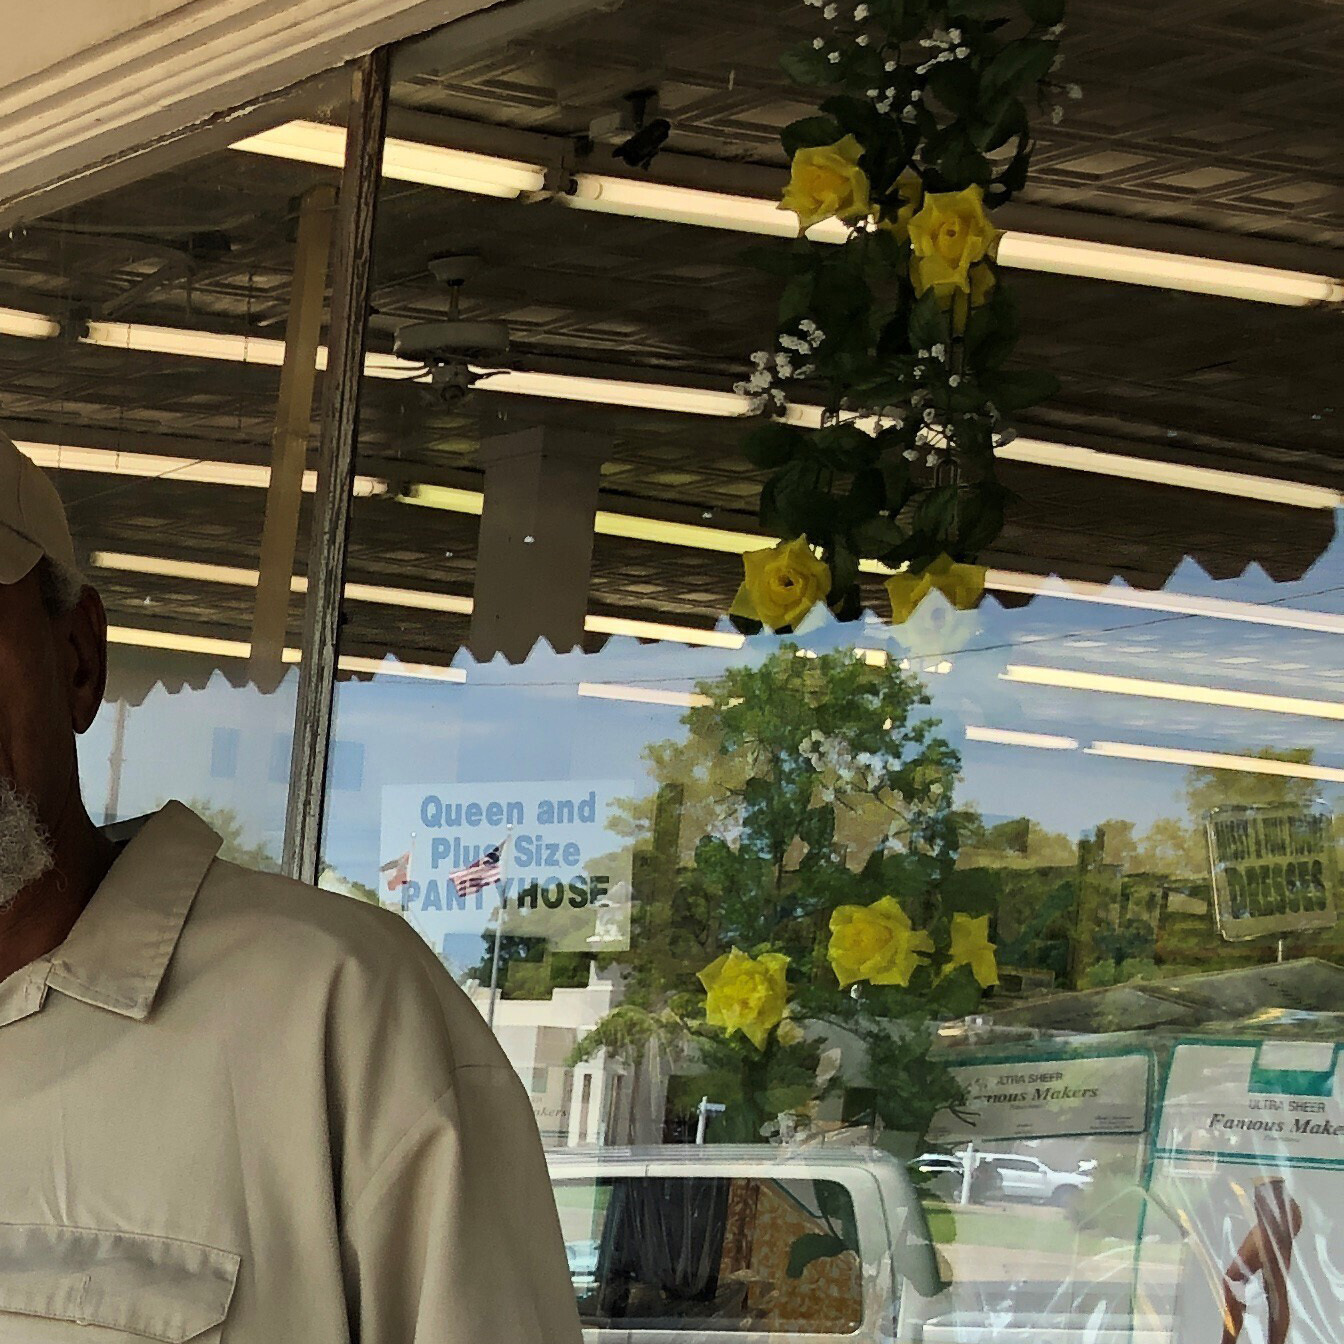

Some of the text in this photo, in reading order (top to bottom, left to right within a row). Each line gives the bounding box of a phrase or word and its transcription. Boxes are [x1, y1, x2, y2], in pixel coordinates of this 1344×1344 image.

[420, 791, 596, 828] Queen and
[514, 835, 581, 868] Size
[1032, 1086, 1099, 1101] Makers
[1248, 1099, 1325, 1113] ULTRA SHEER
[1209, 1113, 1344, 1136] Famous Make
